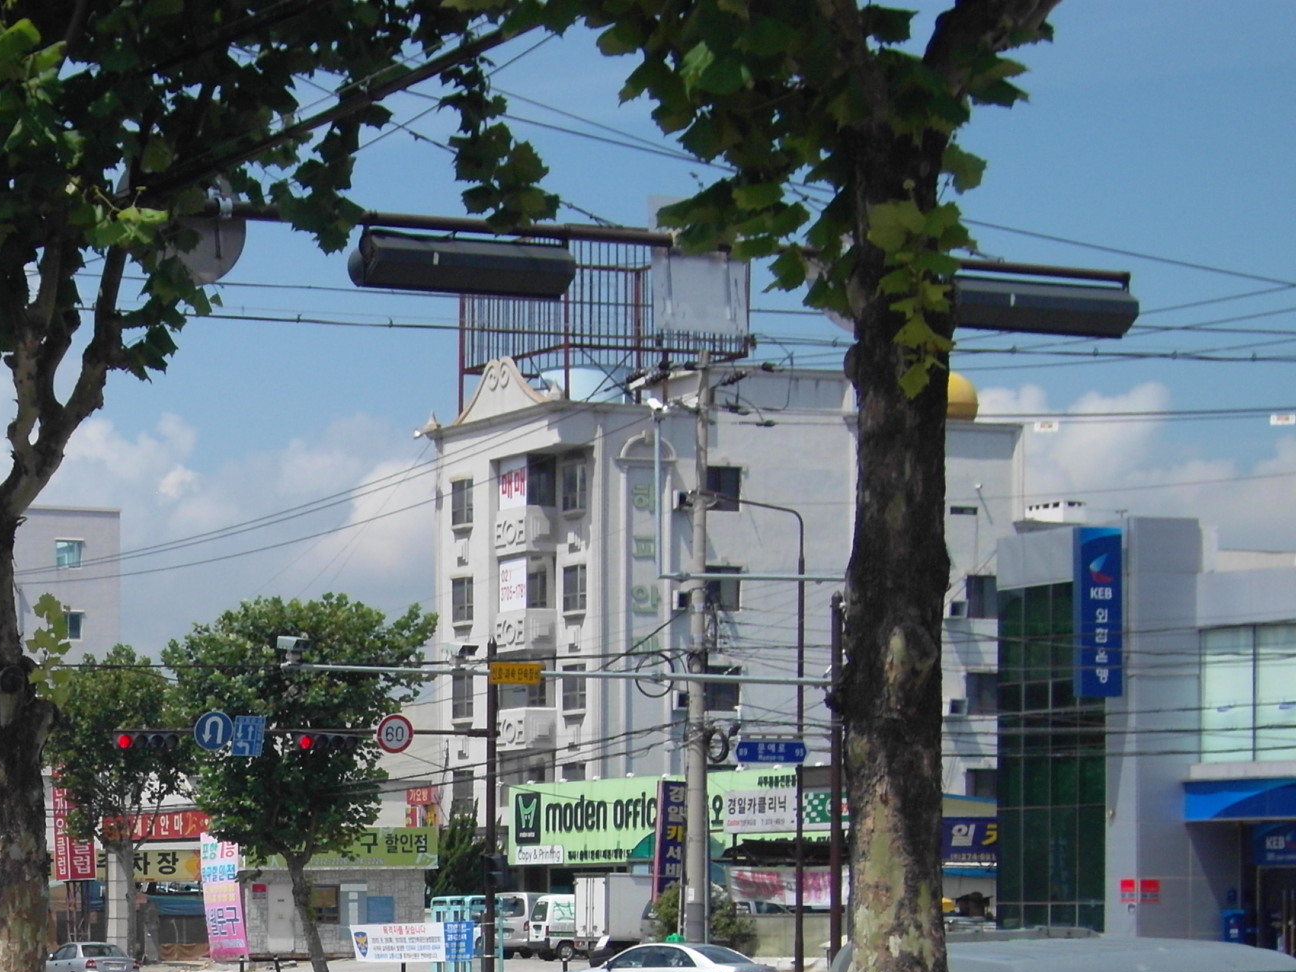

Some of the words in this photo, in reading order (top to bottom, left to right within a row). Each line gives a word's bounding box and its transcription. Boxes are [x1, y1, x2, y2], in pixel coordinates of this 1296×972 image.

[501, 466, 526, 500] 매매
[1090, 587, 1113, 600] KEB
[1095, 608, 1108, 683] 외환은행
[385, 726, 404, 742] 60
[758, 742, 786, 754] 문예로
[409, 789, 428, 802] 가요방
[727, 795, 787, 815] 경일카클리닉
[546, 795, 608, 833] moden
[385, 833, 428, 853] 할인점
[1265, 836, 1285, 849] KEB
[518, 847, 532, 862] Copy
[533, 848, 538, 860] &
[539, 846, 561, 861] Printing
[383, 925, 403, 935] 목격자를
[405, 925, 426, 935] 찾습니다
